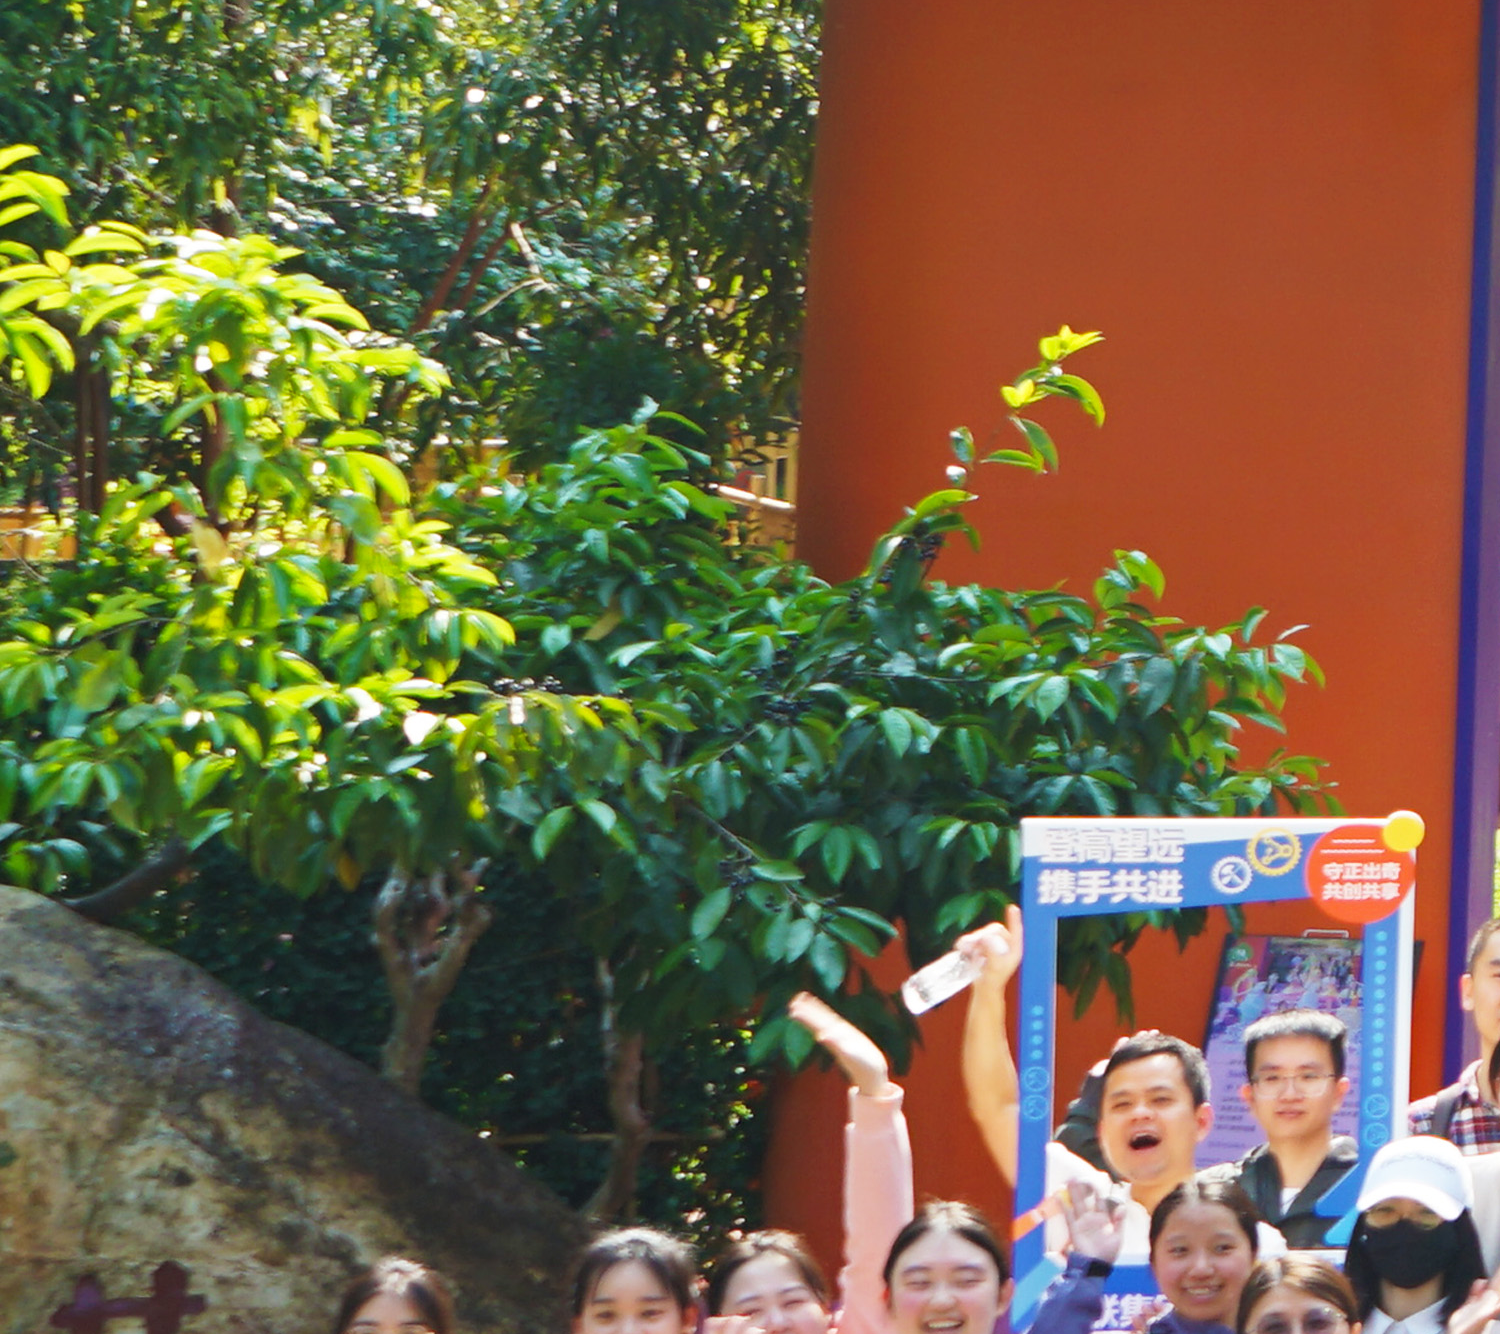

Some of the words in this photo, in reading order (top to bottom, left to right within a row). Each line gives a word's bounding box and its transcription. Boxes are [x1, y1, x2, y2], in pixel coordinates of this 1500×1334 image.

[1041, 827, 1186, 864] 登高望远
[1322, 861, 1401, 881] 守正出奇
[1039, 869, 1184, 904] 携手共进
[1322, 882, 1401, 901] 共创共享
